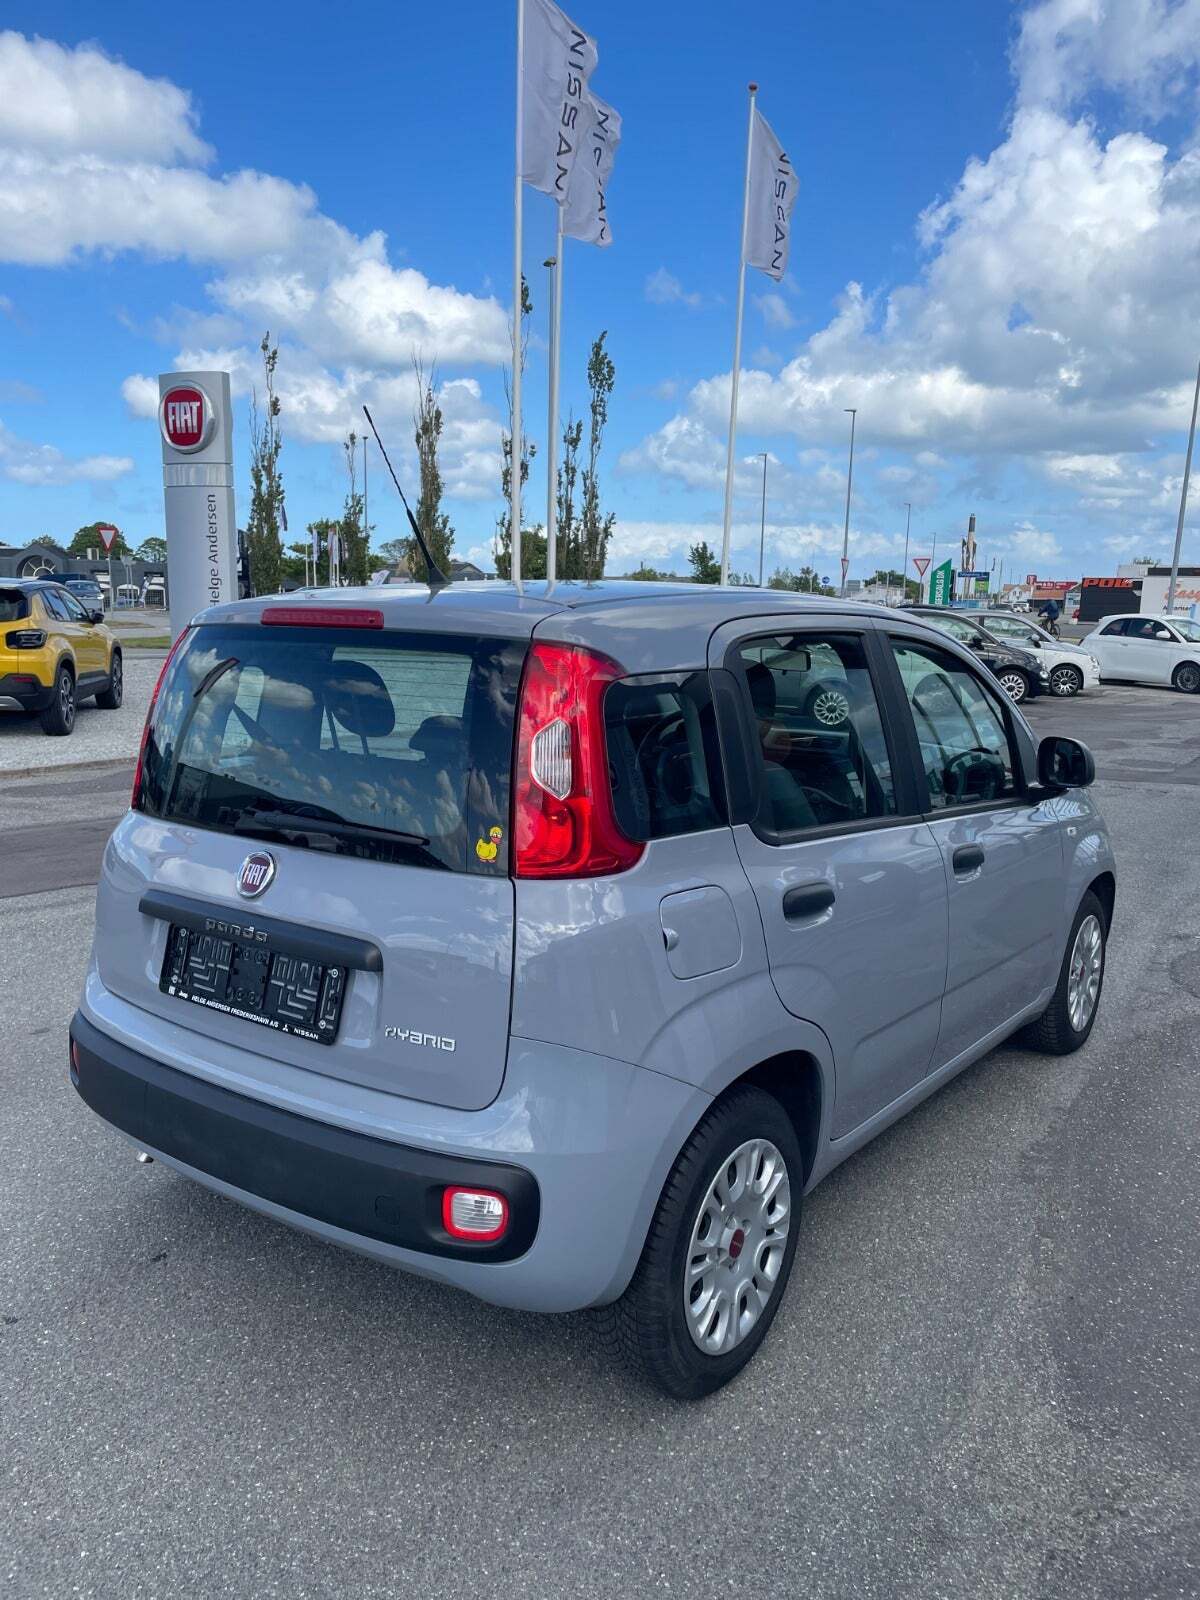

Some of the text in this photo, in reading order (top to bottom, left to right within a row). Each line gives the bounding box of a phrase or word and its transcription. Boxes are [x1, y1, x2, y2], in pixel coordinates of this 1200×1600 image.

[555, 30, 587, 191] NISSAN
[167, 402, 200, 434] FIAT
[206, 494, 217, 563] Andersen
[243, 863, 267, 886] FIAT
[206, 1000, 231, 1012] ANDERSEN
[293, 1027, 319, 1040] NISSAN
[385, 1025, 456, 1052] HYBRID
